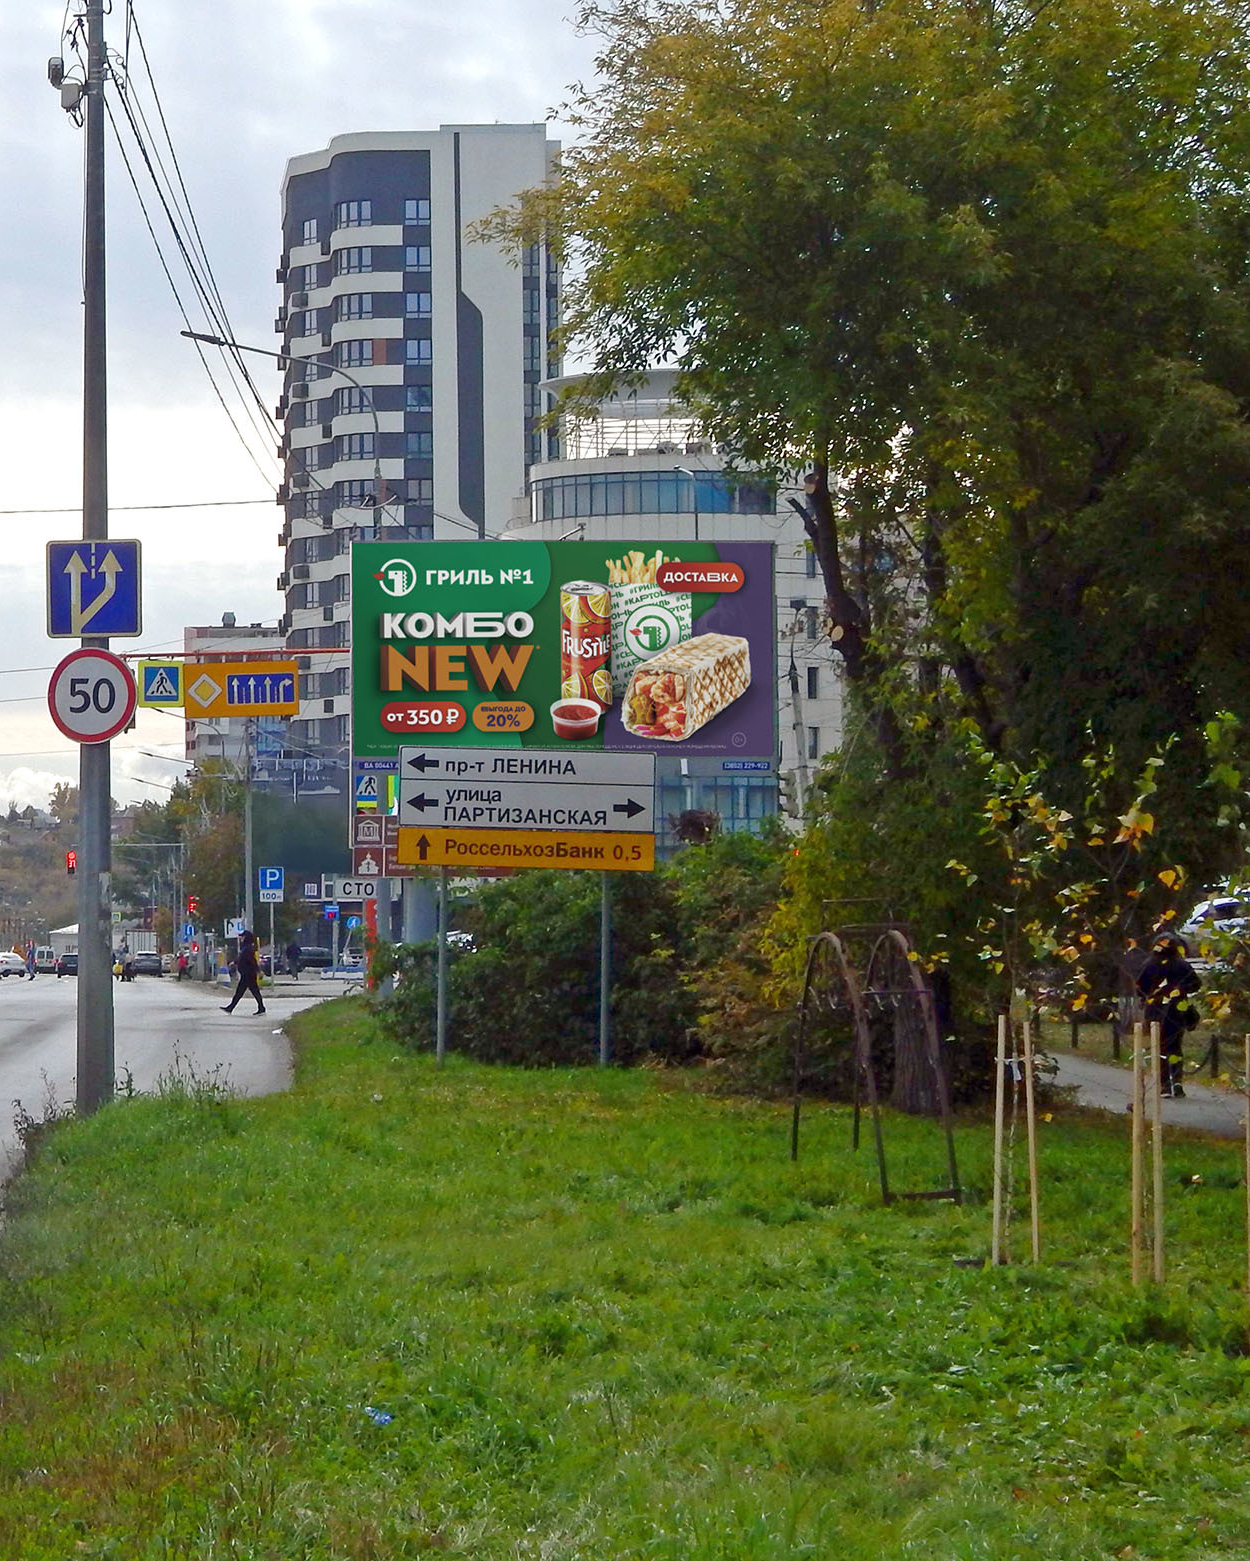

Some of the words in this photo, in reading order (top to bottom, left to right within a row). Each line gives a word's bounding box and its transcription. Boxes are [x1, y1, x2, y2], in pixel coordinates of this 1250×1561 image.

[426, 569, 494, 585] ГРИЛЬ
[500, 569, 534, 585] №1
[663, 571, 739, 584] ДОСТАВКА
[380, 611, 534, 639] КОМБО
[381, 643, 535, 692] NEW
[69, 677, 116, 714] 50
[386, 712, 404, 722] от
[406, 709, 443, 725] 350
[481, 705, 514, 713] ВЫГОДА
[515, 705, 526, 713] ДО
[486, 713, 521, 728] 20%
[445, 760, 485, 776] пр-т
[492, 758, 576, 776] ЛЕНИНА
[445, 789, 502, 805] улица
[444, 806, 607, 826] ПАРТИЗАНСКАЯ
[445, 838, 605, 859] РоссельхозБанк
[613, 844, 642, 862] 0,5
[342, 882, 375, 896] СТО
